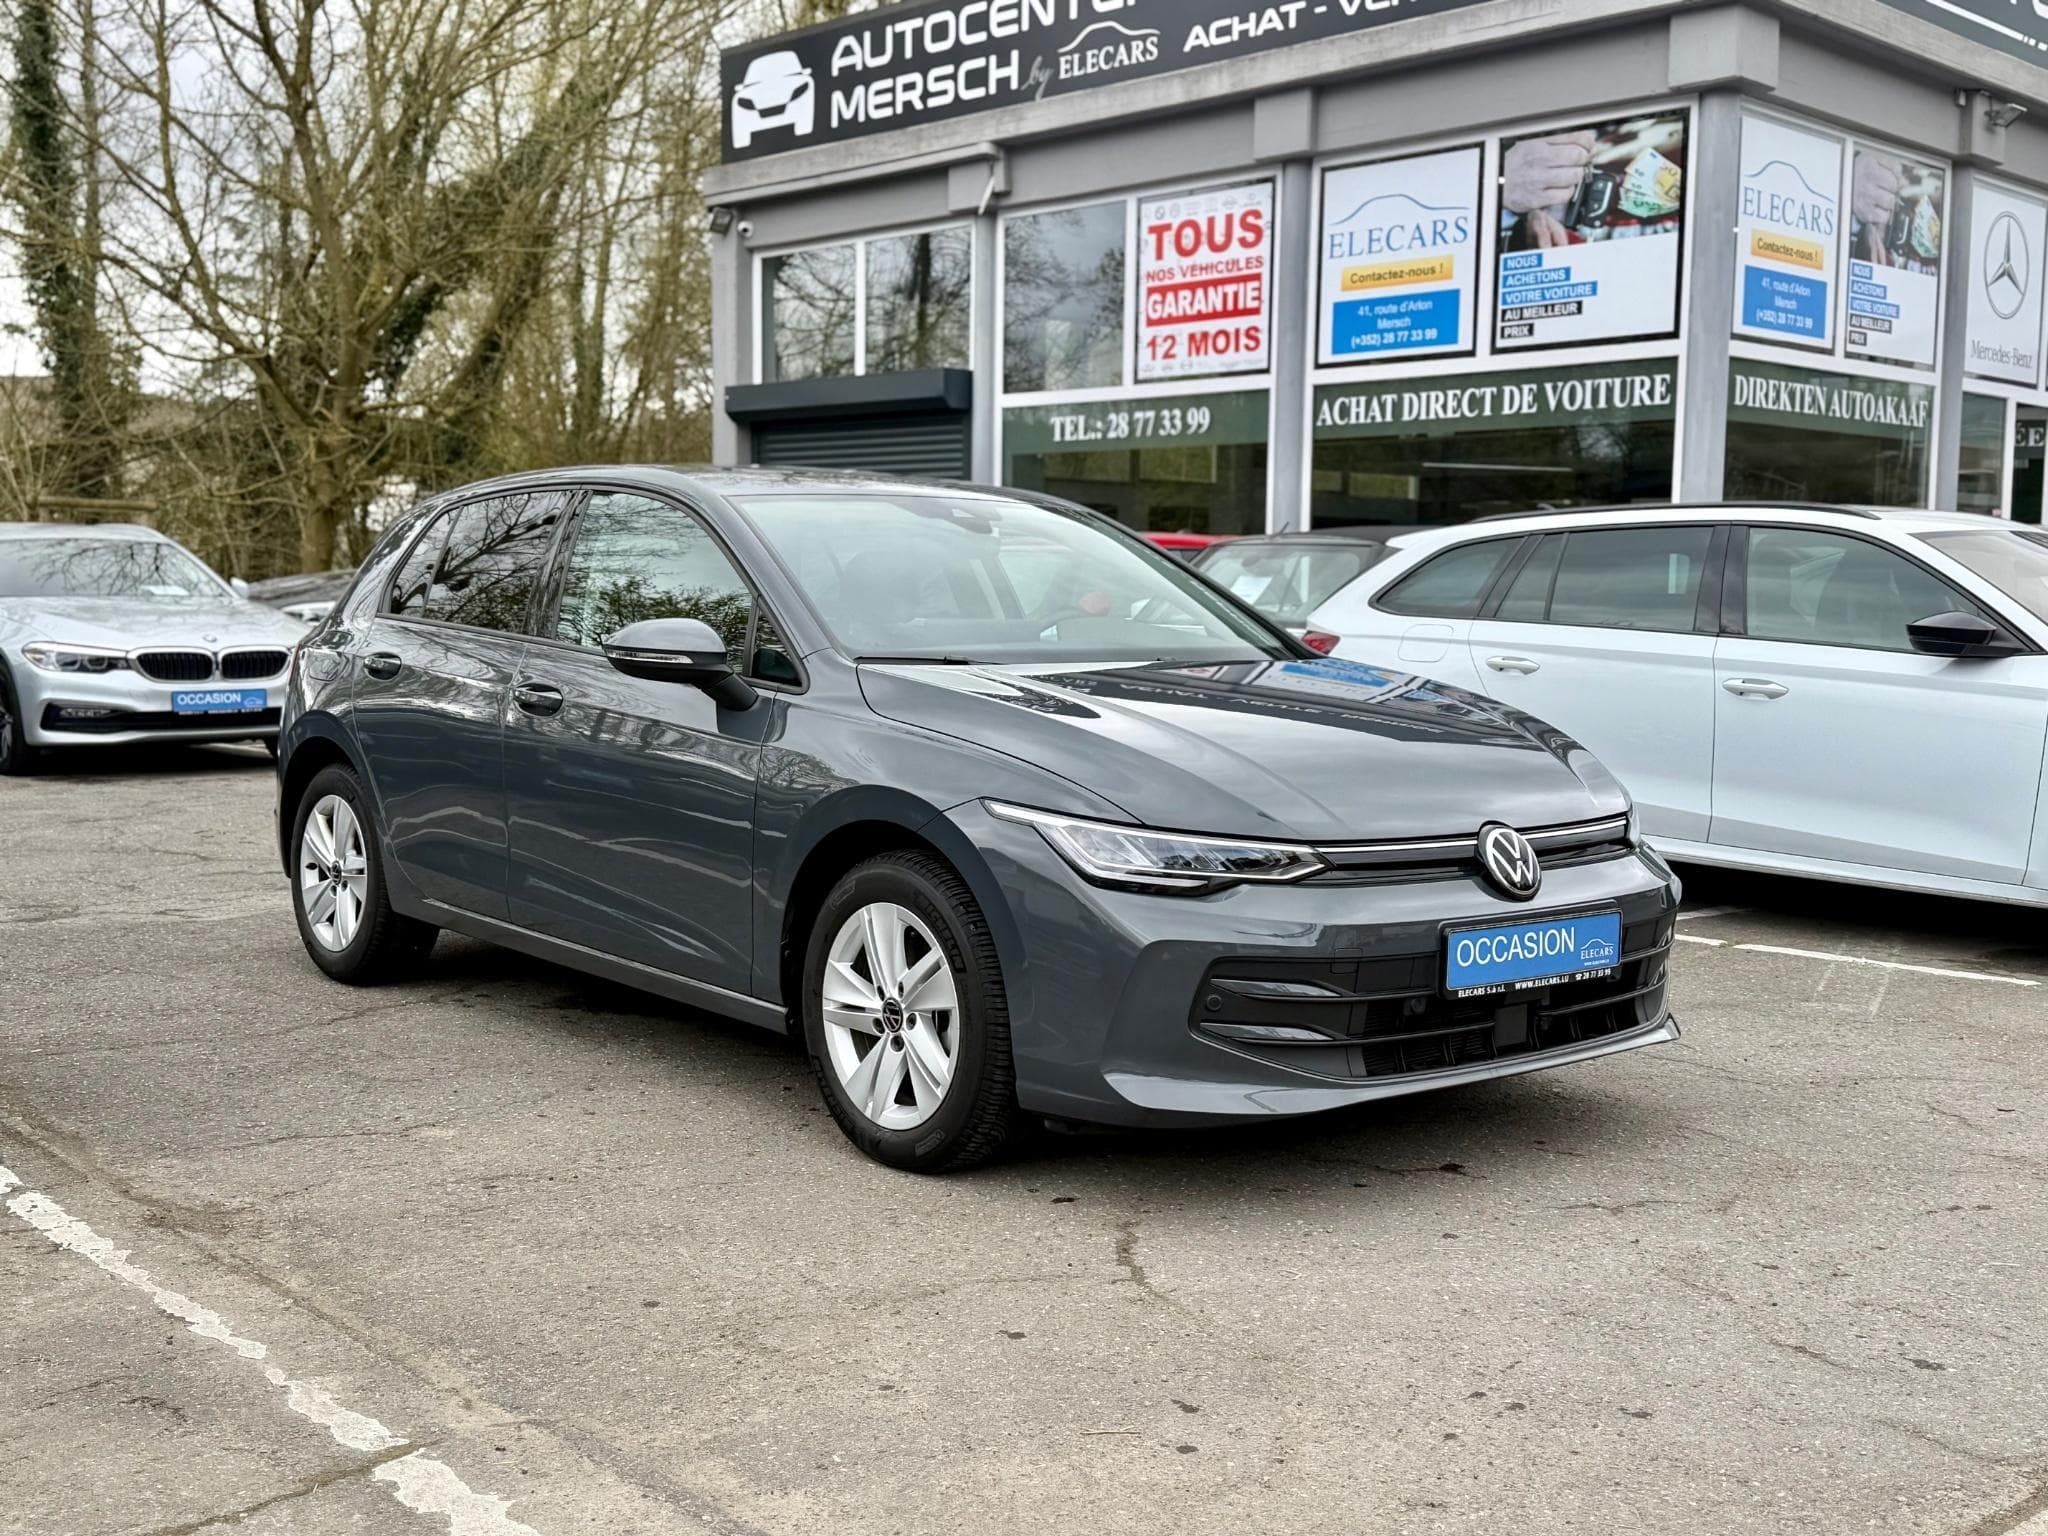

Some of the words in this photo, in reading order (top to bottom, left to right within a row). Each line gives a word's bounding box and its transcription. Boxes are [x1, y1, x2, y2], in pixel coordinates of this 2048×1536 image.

[1183, 2, 1306, 52] ACHAT
[830, 49, 1020, 129] MERSCH
[1021, 55, 1054, 101] by
[1058, 36, 1159, 80] ELECARS
[1743, 186, 1834, 236] ELECARS
[1147, 208, 1264, 261] TOUS
[1328, 216, 1469, 260] ELECARS
[1757, 237, 1814, 262] Contactez-nous
[1506, 255, 1538, 269] NOUS
[1146, 267, 1176, 281] NOS
[1350, 265, 1437, 284] Contactez-nous
[1505, 268, 1566, 287] ACHETONS
[1146, 280, 1261, 320] GARANTIE
[1505, 289, 1542, 304] VOTRE
[1544, 283, 1593, 300] VOITURE
[1374, 303, 1398, 315] route
[1504, 308, 1521, 321] AU
[1522, 302, 1578, 319] MEILLEUR
[1376, 317, 1412, 330] Mersch
[1504, 325, 1530, 338] PRIX
[1146, 333, 1177, 361] 12
[1187, 325, 1262, 358] MOIS
[1382, 332, 1395, 344] 28
[1396, 331, 1410, 343] 77
[1411, 329, 1423, 342] 33
[1970, 338, 2034, 369] Mercedes-Benz
[1316, 393, 1397, 426] ACHAT
[1401, 387, 1497, 422] DIRECT
[1501, 383, 1538, 416] DE
[1543, 373, 1672, 413] VOITURE
[1733, 374, 1827, 416] DIREKTEN
[1828, 388, 1929, 428] AUTOAKAAF
[1106, 412, 1130, 439] 28
[1133, 409, 1156, 438] 77
[1158, 408, 1182, 436] 33
[1186, 406, 1211, 435] 99
[177, 692, 242, 705] OCCASION
[1456, 926, 1576, 968] OCCASION
[1580, 946, 1614, 960] ELECARS
[1458, 986, 1486, 998] ELECARS
